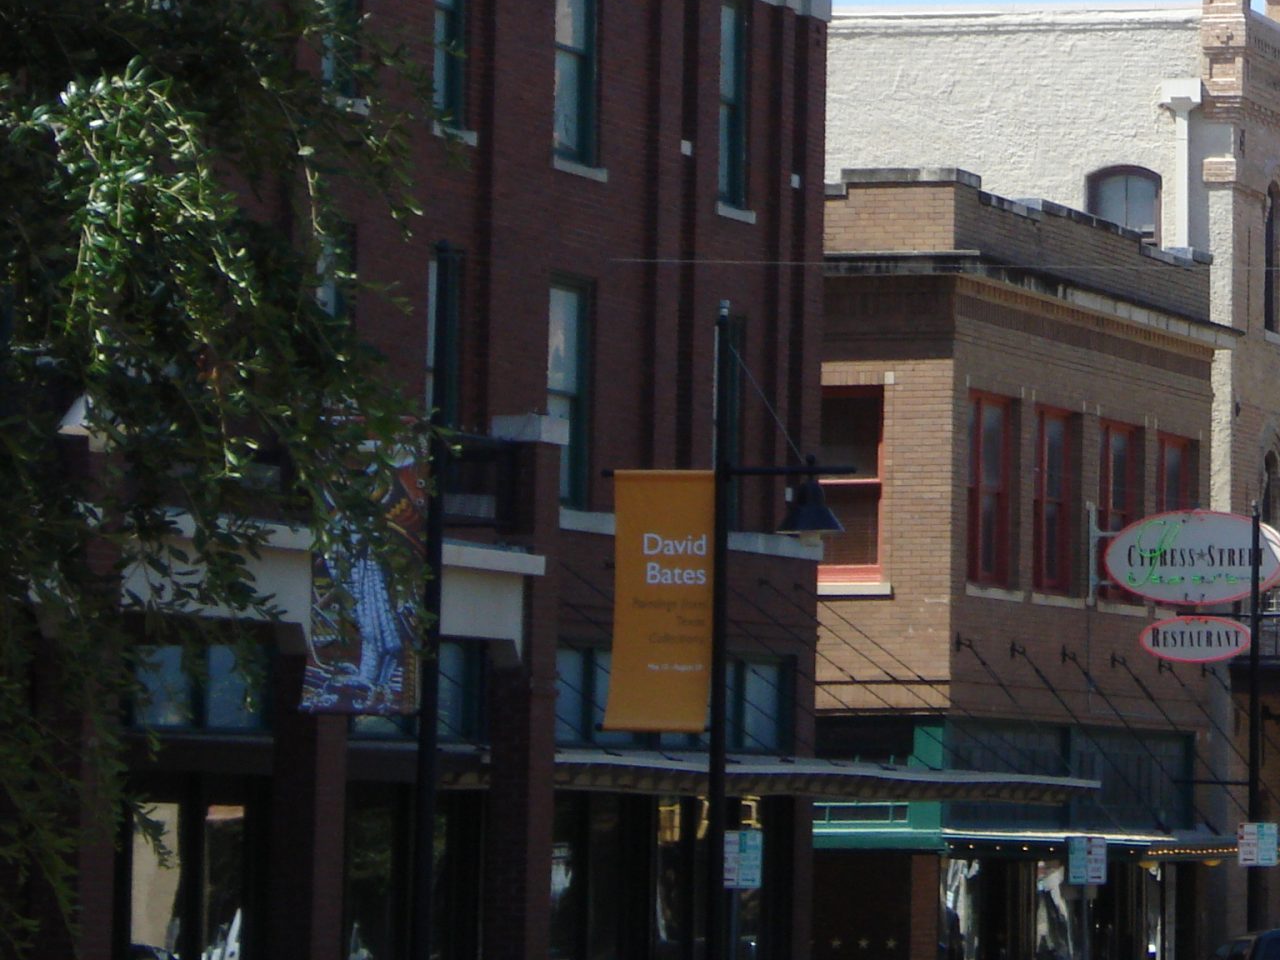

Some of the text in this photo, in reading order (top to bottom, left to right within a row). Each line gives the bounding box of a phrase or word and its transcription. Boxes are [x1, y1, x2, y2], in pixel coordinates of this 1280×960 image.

[643, 533, 706, 555] David
[1127, 544, 1196, 568] CYPRESS
[646, 562, 706, 584] Bates
[1152, 628, 1241, 648] RESTAURANT
